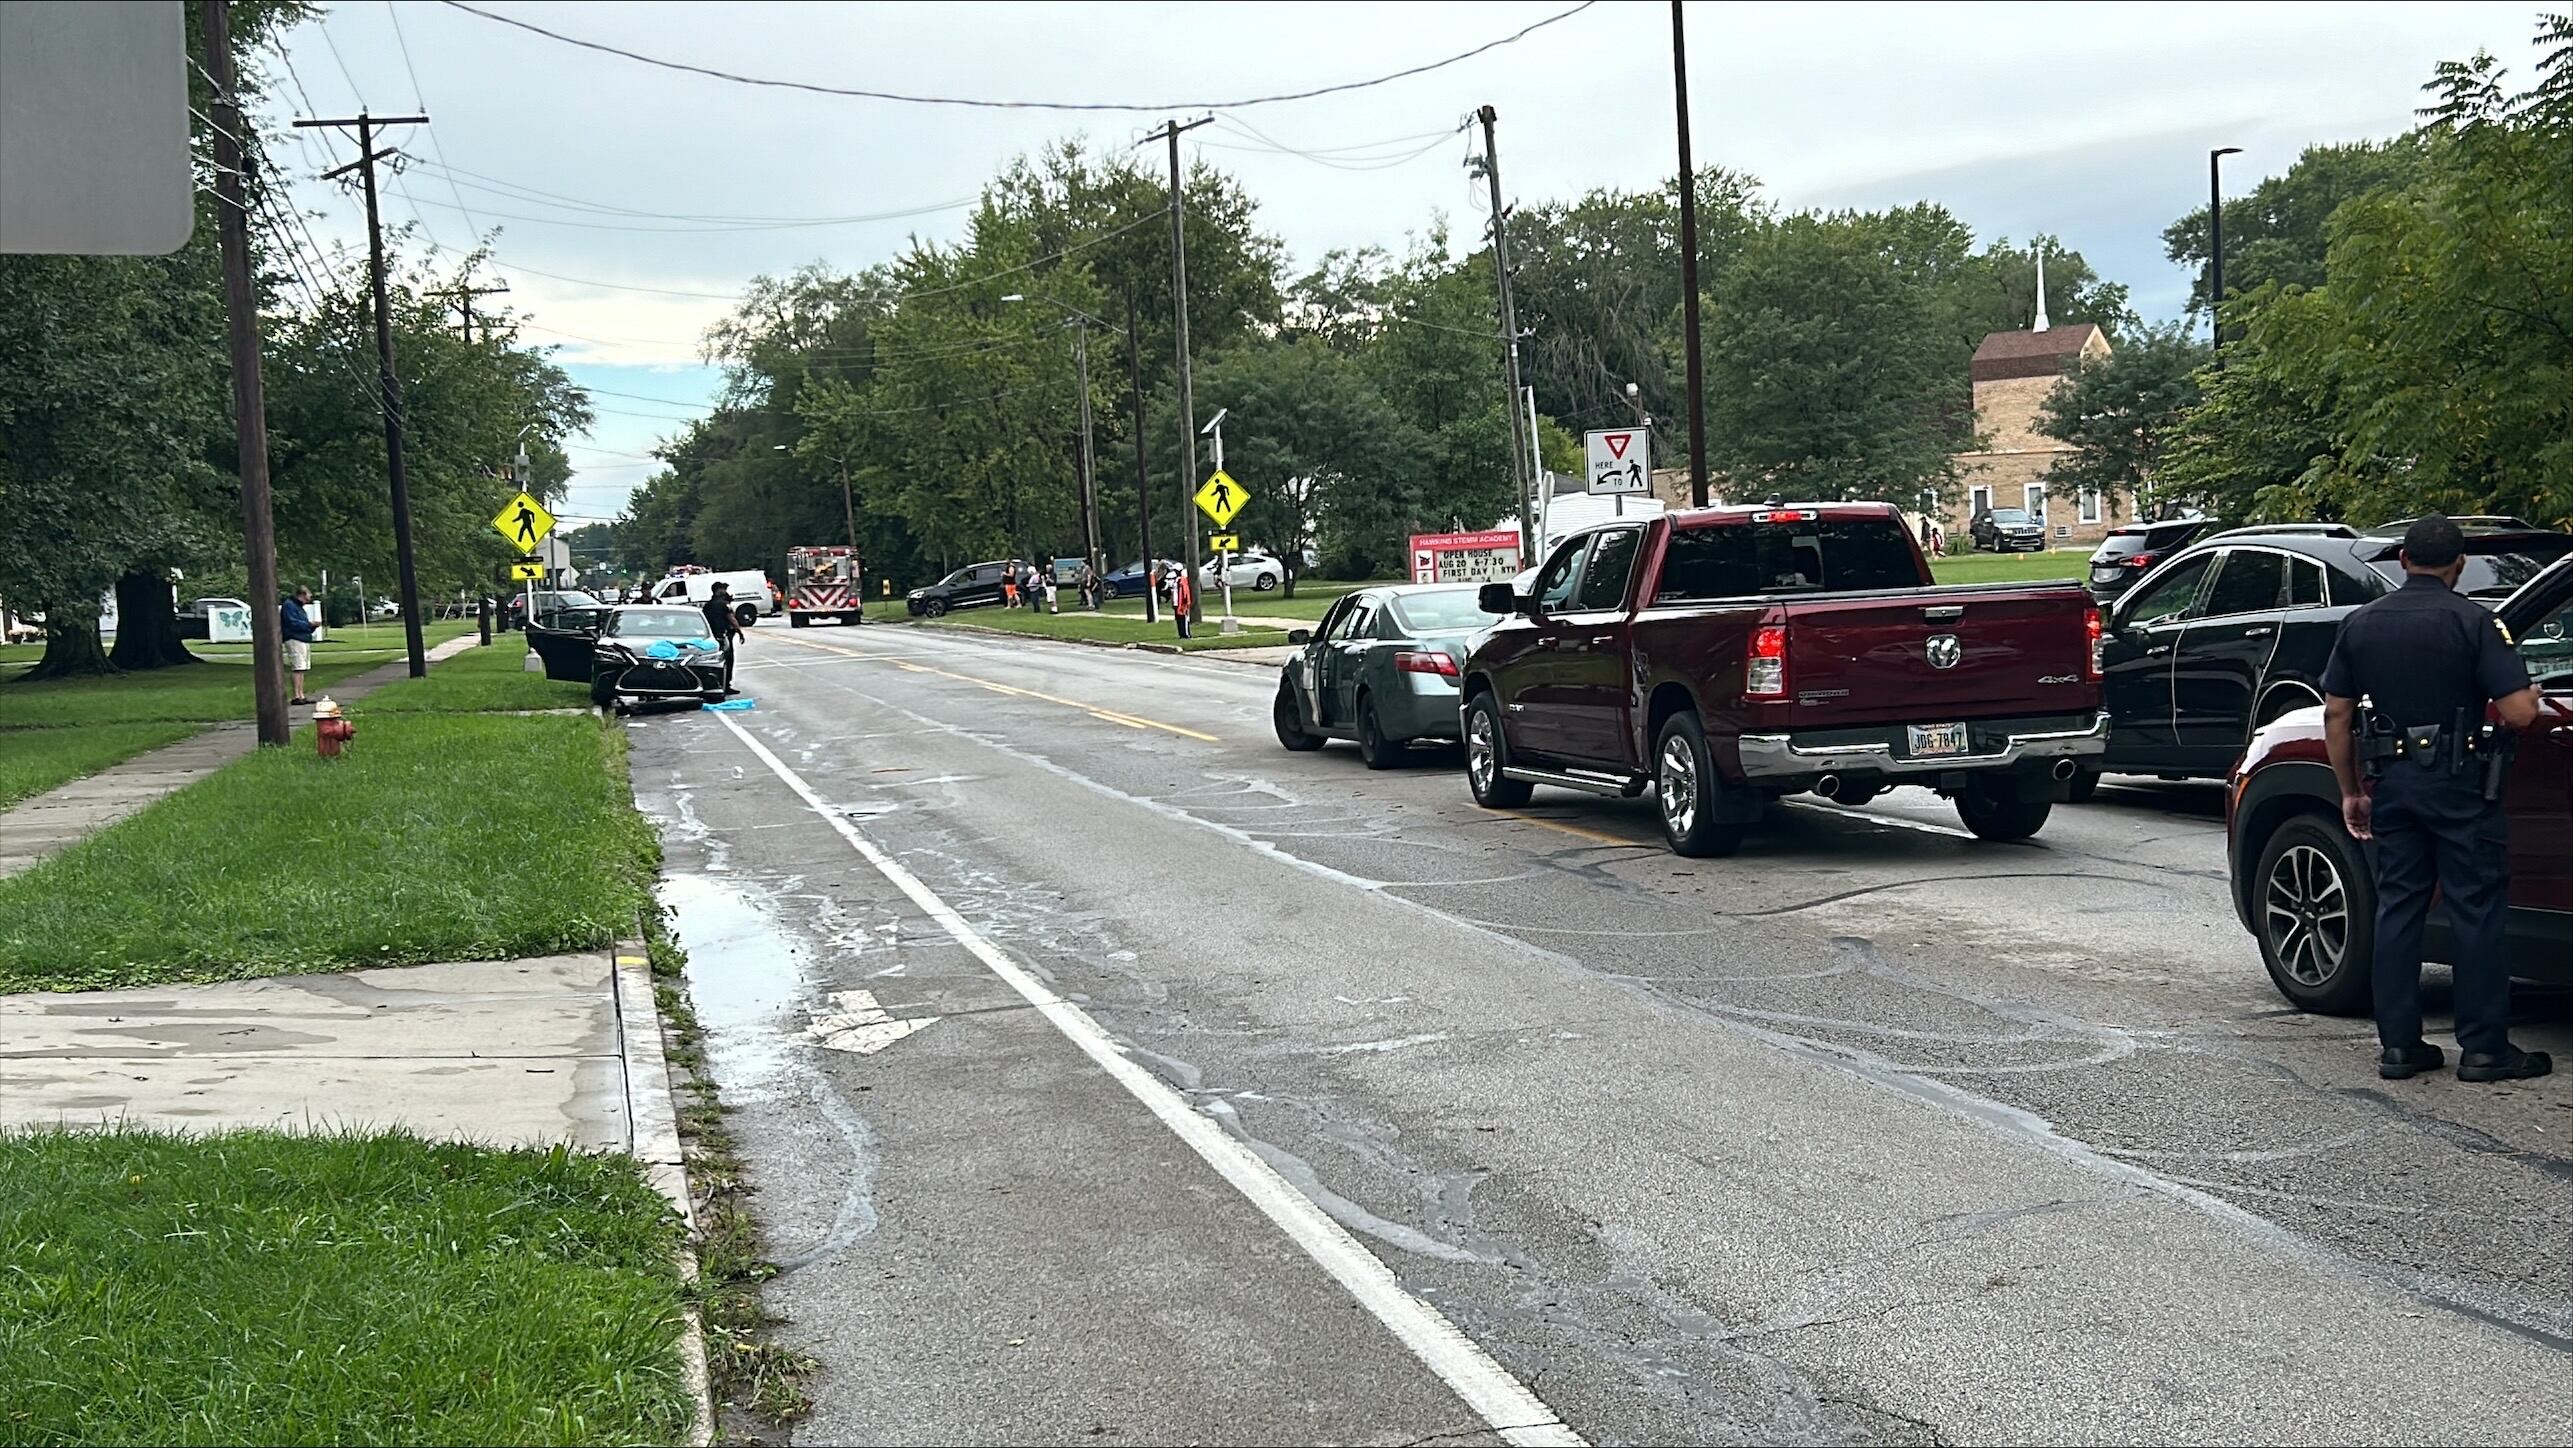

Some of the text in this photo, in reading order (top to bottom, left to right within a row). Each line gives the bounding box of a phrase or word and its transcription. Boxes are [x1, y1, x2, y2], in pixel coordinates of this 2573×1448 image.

[1595, 461, 1613, 469] HERE
[1479, 534, 1513, 543] ACADEMY
[1444, 549, 1492, 559] OPEN HOUSE
[1443, 568, 1467, 577] FIRST
[1471, 567, 1487, 576] DAY
